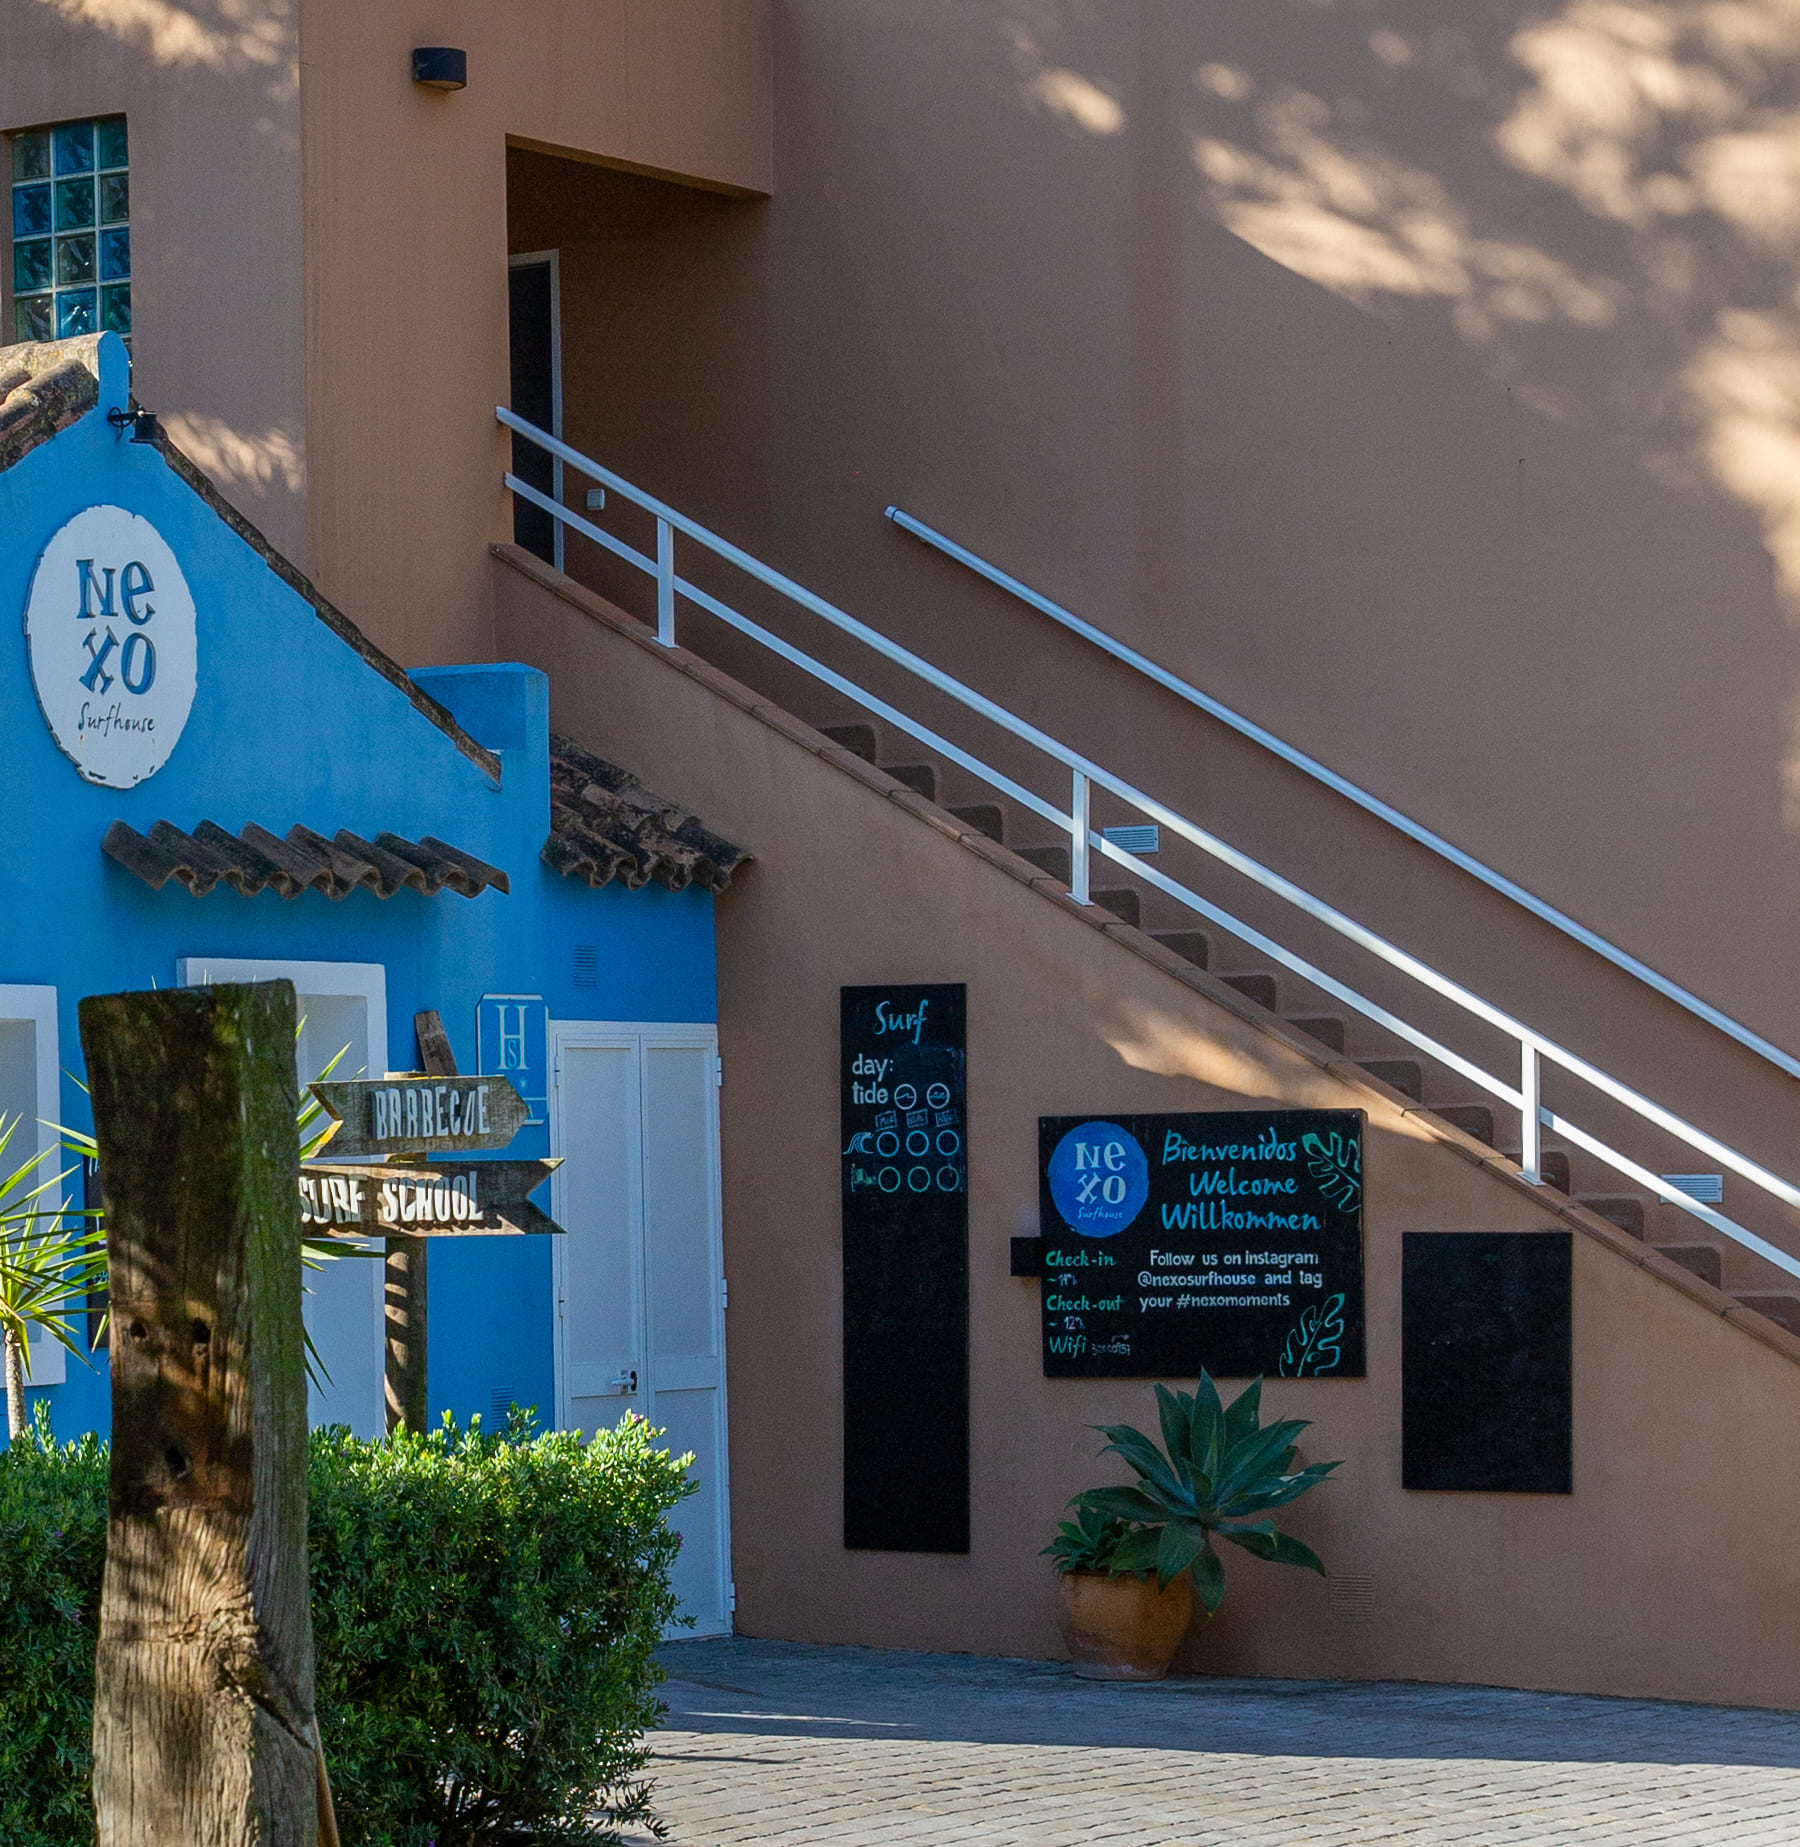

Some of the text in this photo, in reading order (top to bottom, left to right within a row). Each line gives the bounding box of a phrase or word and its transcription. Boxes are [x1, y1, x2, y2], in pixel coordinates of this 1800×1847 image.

[77, 701, 156, 738] Surfhouse
[872, 999, 929, 1046] Surf
[851, 1052, 894, 1083] day:
[851, 1080, 889, 1105] tide
[373, 1085, 491, 1141] BARBECUE
[1161, 1126, 1297, 1166] Bienvenidos
[1189, 1166, 1299, 1197] Welcome
[381, 1170, 485, 1224] SCHOOL
[1077, 1205, 1124, 1222] Surfhouse
[1160, 1199, 1322, 1231] Willkommen
[1045, 1249, 1117, 1268] Check-in
[1149, 1249, 1320, 1269] Follow us on instagram
[1137, 1269, 1323, 1289] @nexosurfhouse and tag
[1046, 1293, 1126, 1312] Check-out
[1138, 1292, 1291, 1313] your #nexomoments
[1049, 1333, 1088, 1360] Wifi
